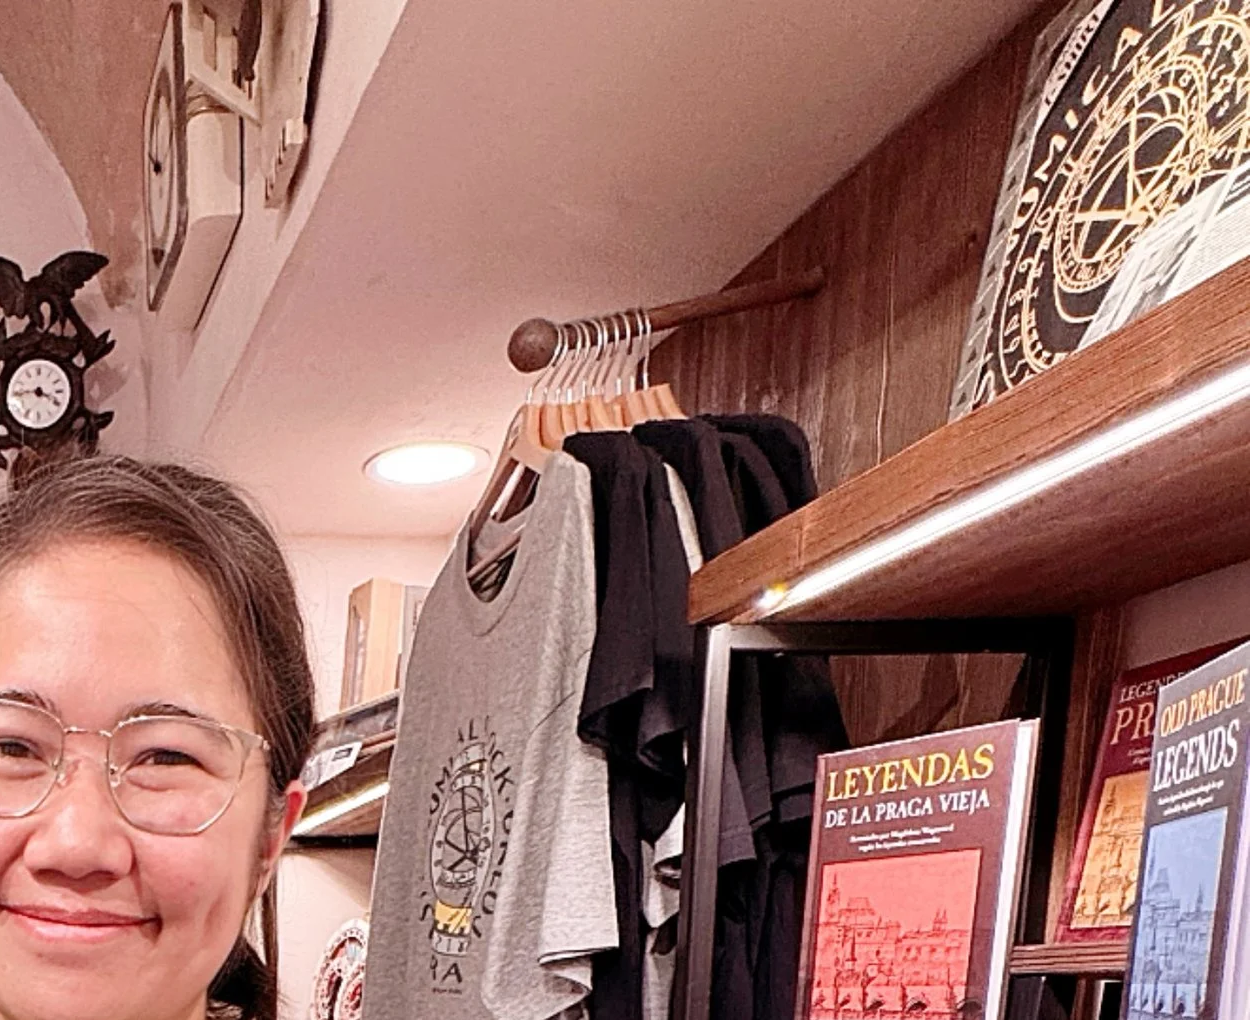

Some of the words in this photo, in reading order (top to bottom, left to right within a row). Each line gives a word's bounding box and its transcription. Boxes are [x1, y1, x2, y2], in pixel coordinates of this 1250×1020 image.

[1160, 698, 1187, 737] OLD
[1187, 667, 1249, 727] PRAGUE
[826, 743, 995, 802] LEYENDAS
[1152, 717, 1241, 793] LEGENDS
[824, 808, 849, 829] DE
[850, 805, 871, 825] LA
[875, 797, 933, 822] PRAGA
[939, 788, 990, 816] VIEJA
